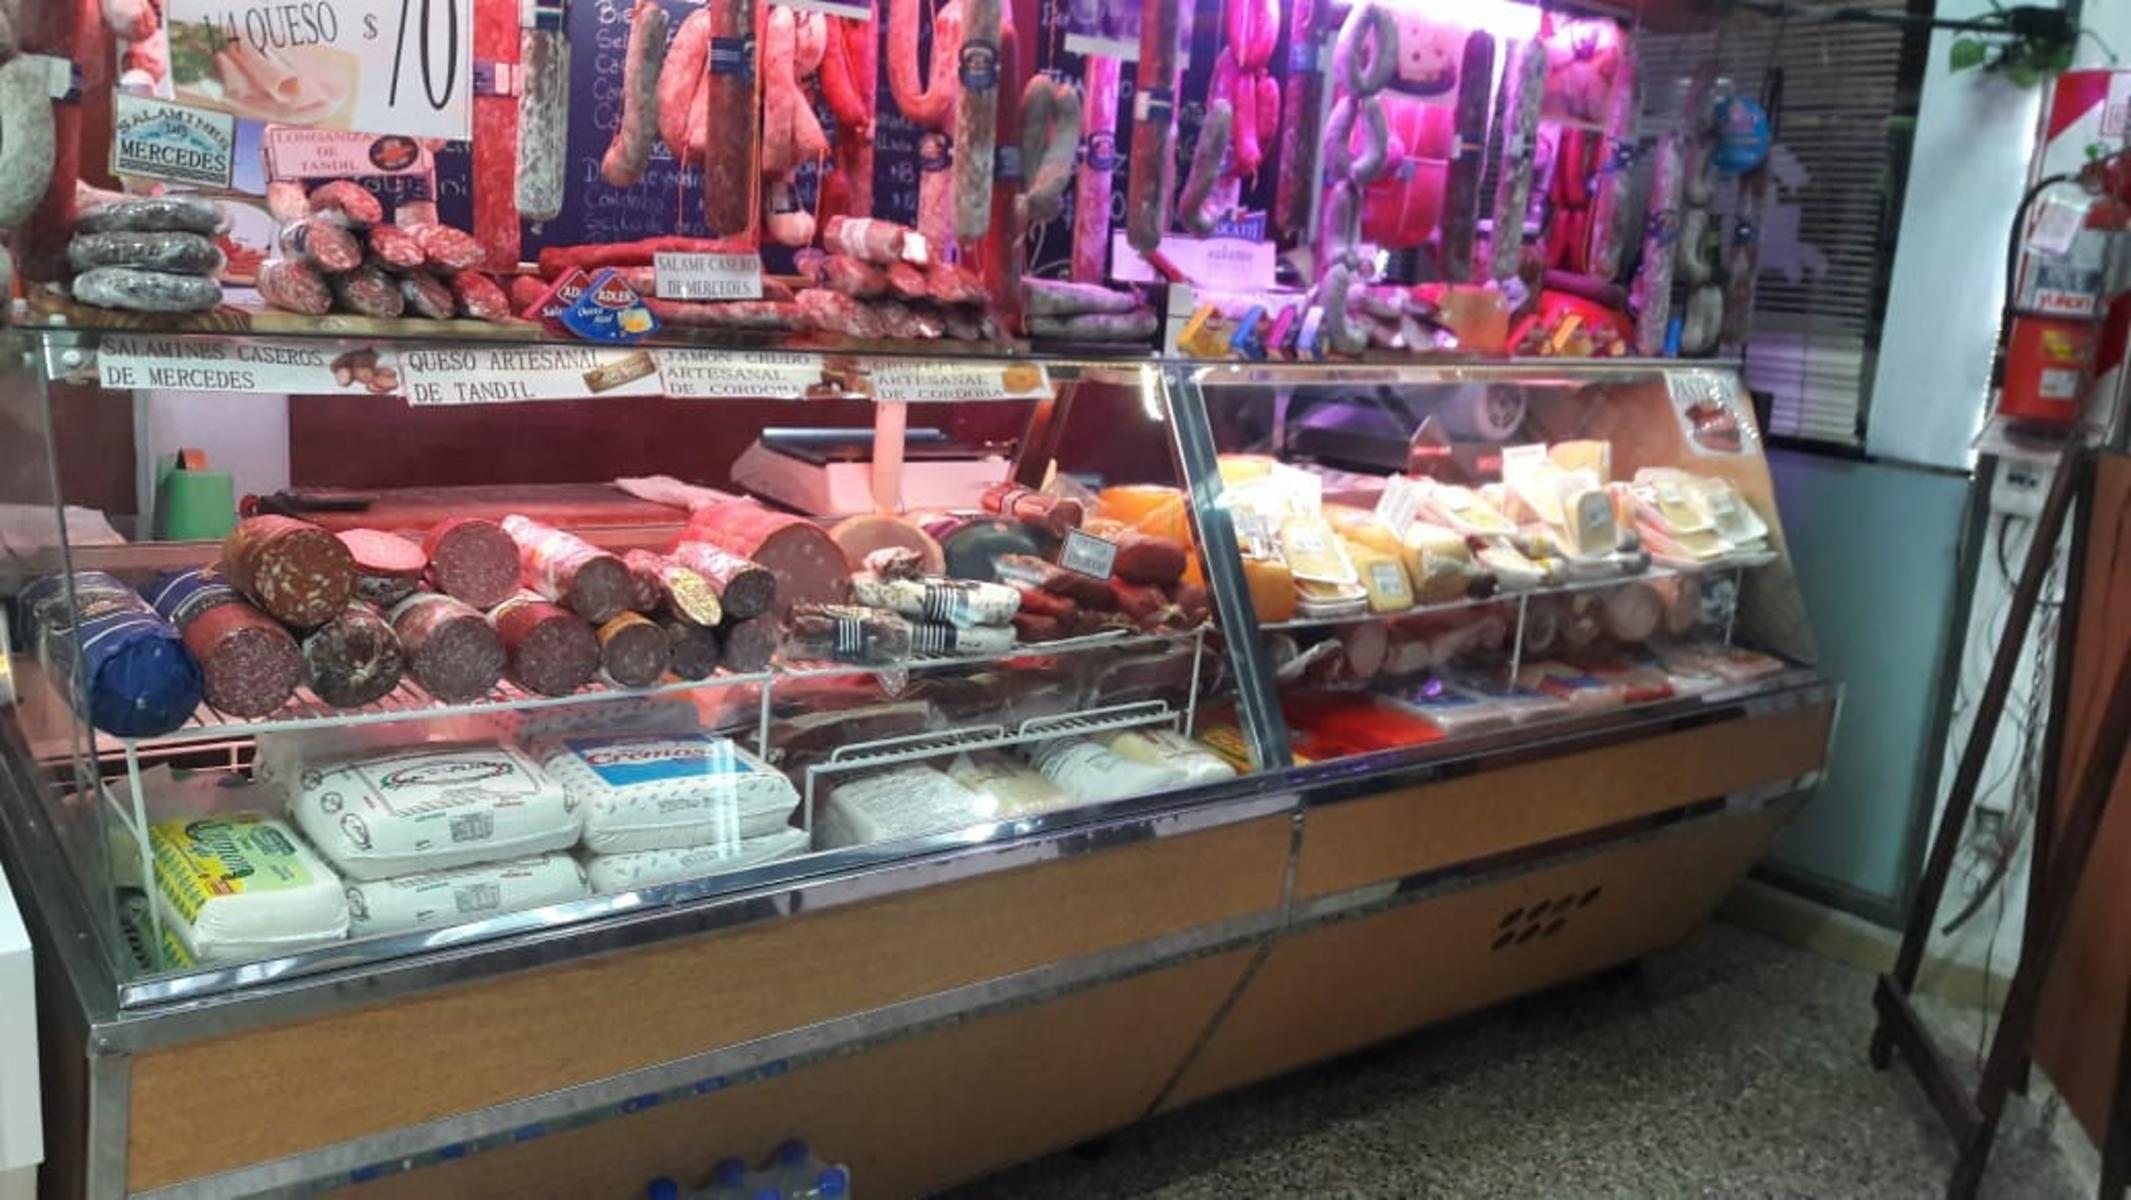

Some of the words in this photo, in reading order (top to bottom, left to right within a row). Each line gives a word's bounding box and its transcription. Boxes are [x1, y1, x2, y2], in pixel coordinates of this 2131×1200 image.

[246, 1, 338, 57] QUESO
[362, 13, 379, 40] $
[121, 137, 226, 172] MERCEDES
[317, 146, 338, 158] DE
[301, 158, 359, 171] TANDIL
[598, 289, 632, 303] ADLER
[687, 281, 751, 297] MERCEDES
[104, 338, 227, 361] SALAMINES
[236, 346, 324, 368] CASEROS
[408, 351, 477, 372] QUESO
[490, 348, 604, 371] ARTESANAL
[107, 366, 136, 386] DE
[149, 367, 255, 390] MERCEDES
[667, 367, 787, 381] ARTESANAL
[878, 374, 990, 387] ARTESANAL
[414, 383, 440, 402] DE
[454, 382, 536, 401] TANDIL
[670, 383, 695, 396] DE
[881, 390, 907, 400] DE
